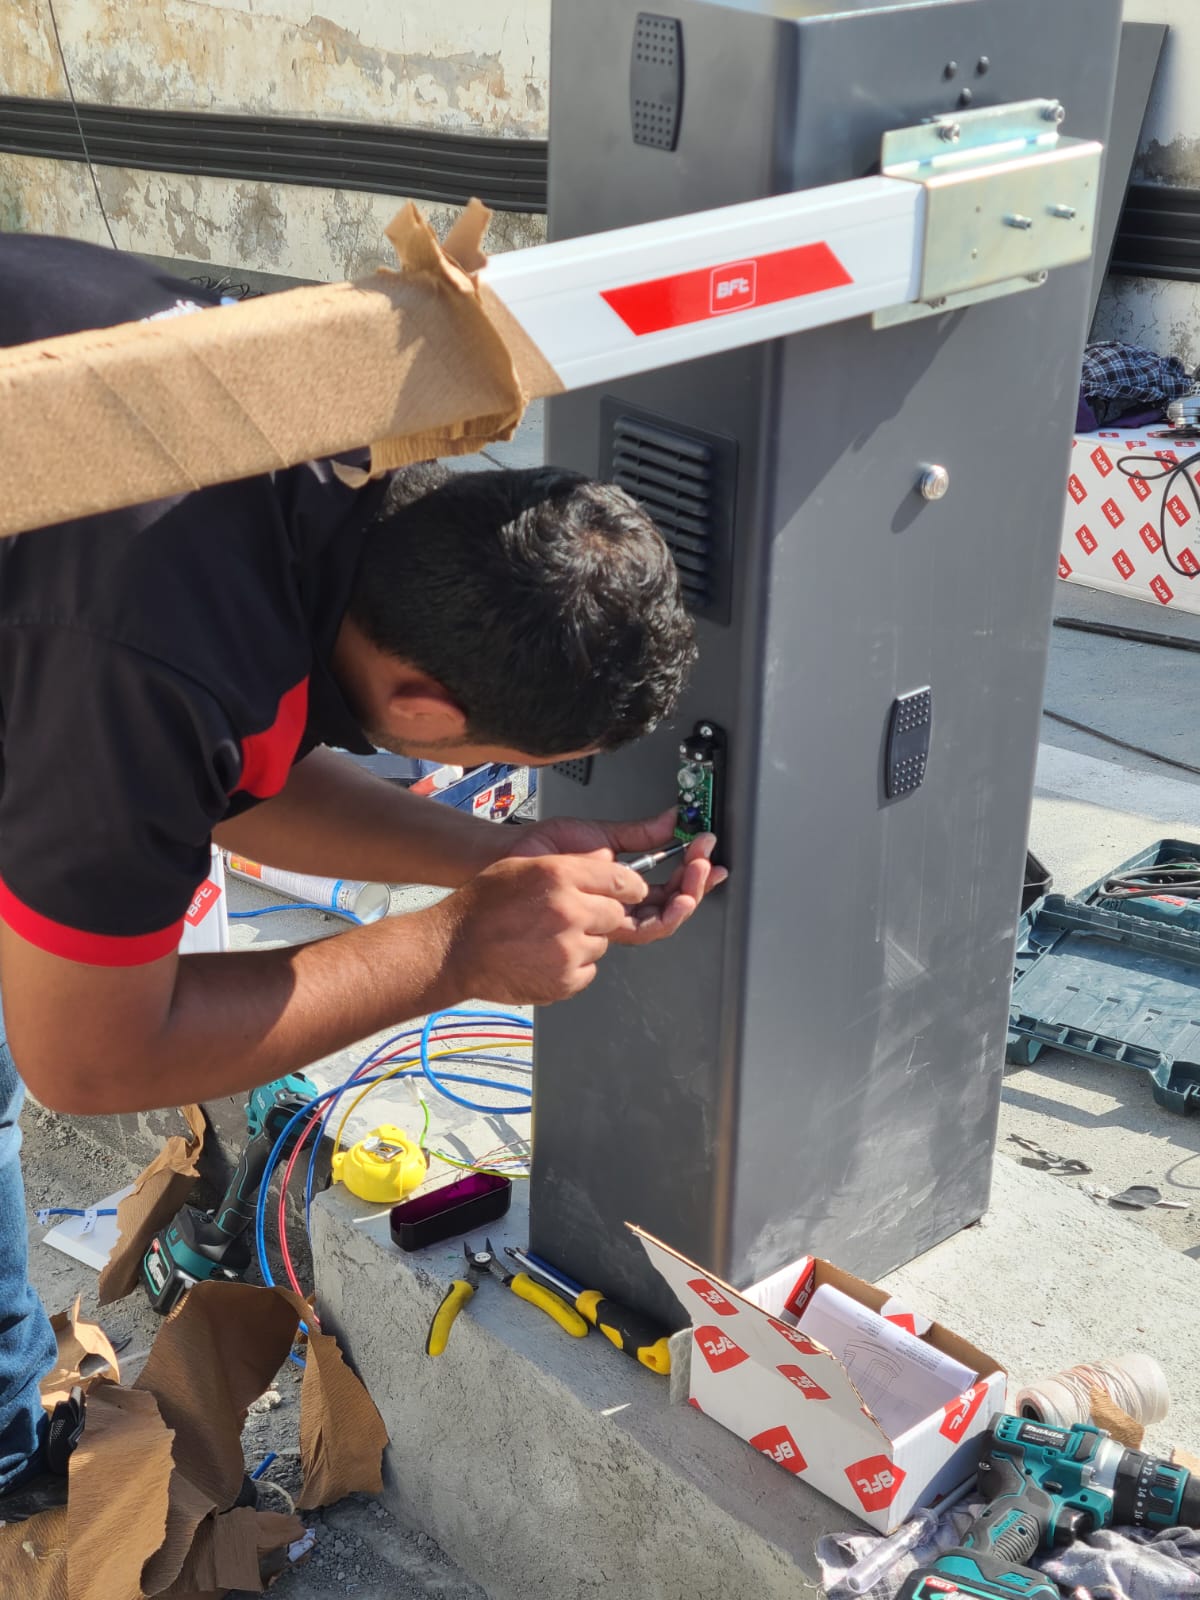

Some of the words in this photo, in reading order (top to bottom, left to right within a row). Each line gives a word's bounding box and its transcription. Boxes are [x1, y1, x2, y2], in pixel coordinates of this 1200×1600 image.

[716, 277, 750, 299] BFt
[1106, 503, 1120, 523] BFt
[1171, 500, 1186, 520] BFt
[1081, 530, 1094, 549] BFt
[1144, 528, 1158, 548] BFt
[1117, 554, 1131, 574] BFt
[1155, 580, 1169, 599] BFt
[186, 887, 212, 918] BFt
[795, 1270, 814, 1309] BF
[949, 1388, 975, 1430] BFt
[1142, 1466, 1153, 1476] 12
[856, 1469, 895, 1494] BFt
[1137, 1487, 1147, 1498] 14
